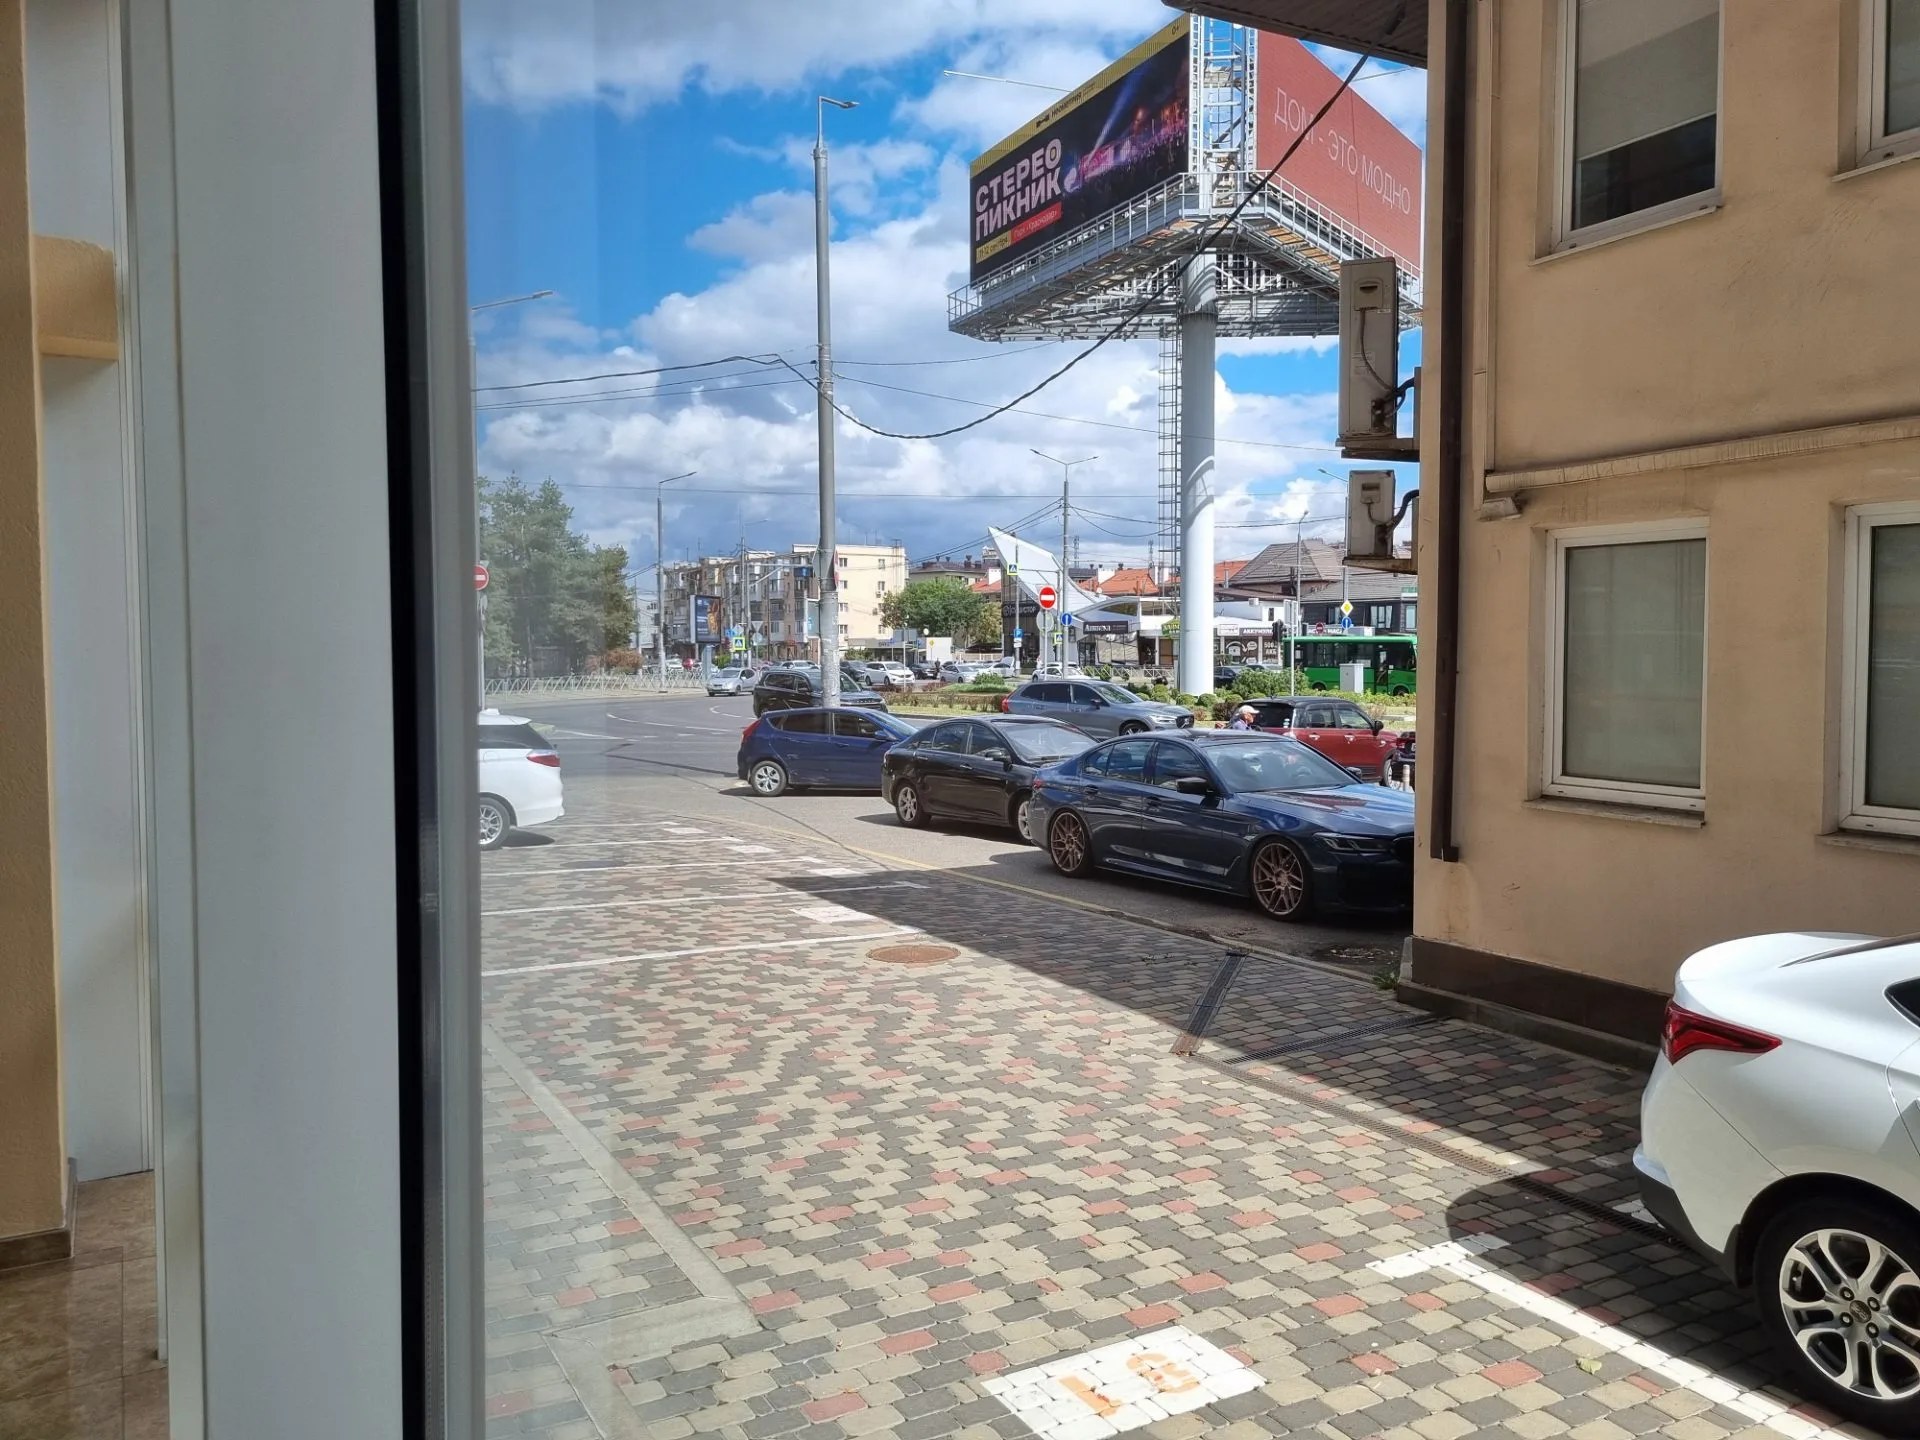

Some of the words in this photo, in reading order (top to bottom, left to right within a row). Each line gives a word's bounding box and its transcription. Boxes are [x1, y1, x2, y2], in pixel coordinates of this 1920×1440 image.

[975, 138, 1062, 213] СТЕРЕО
[1274, 87, 1314, 145] ДОМ
[1328, 129, 1359, 176] ЭТО
[1361, 154, 1411, 215] МОДНО
[975, 166, 1062, 242] ПИКНИК
